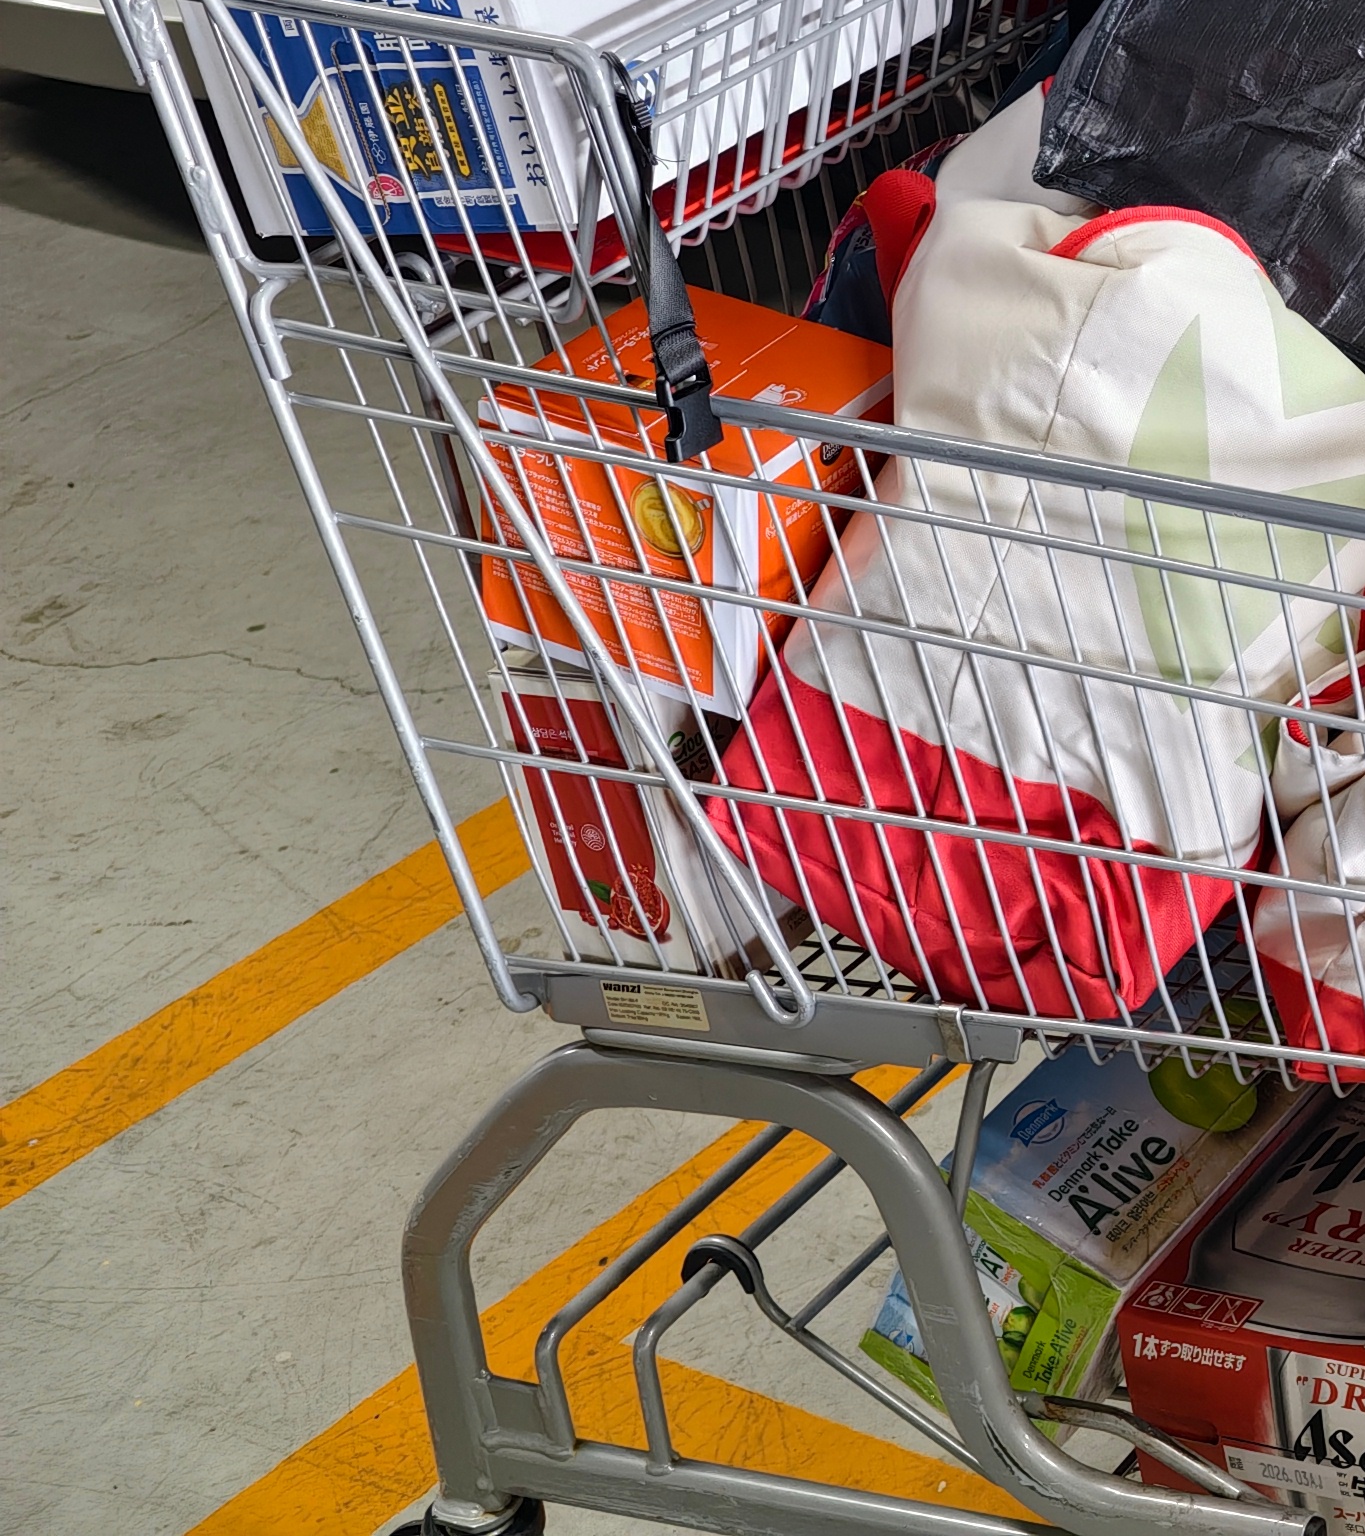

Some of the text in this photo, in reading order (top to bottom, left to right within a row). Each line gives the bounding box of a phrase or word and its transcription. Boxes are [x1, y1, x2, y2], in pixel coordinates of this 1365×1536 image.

[602, 981, 641, 993] wanzl
[1016, 1100, 1060, 1142] Denmark
[1043, 1144, 1106, 1204] Denmark
[1089, 1110, 1143, 1163] Take
[1020, 1338, 1047, 1379] Denmark
[1033, 1350, 1061, 1387] Take
[1131, 1331, 1246, 1374] 1本ずつ取り出せます
